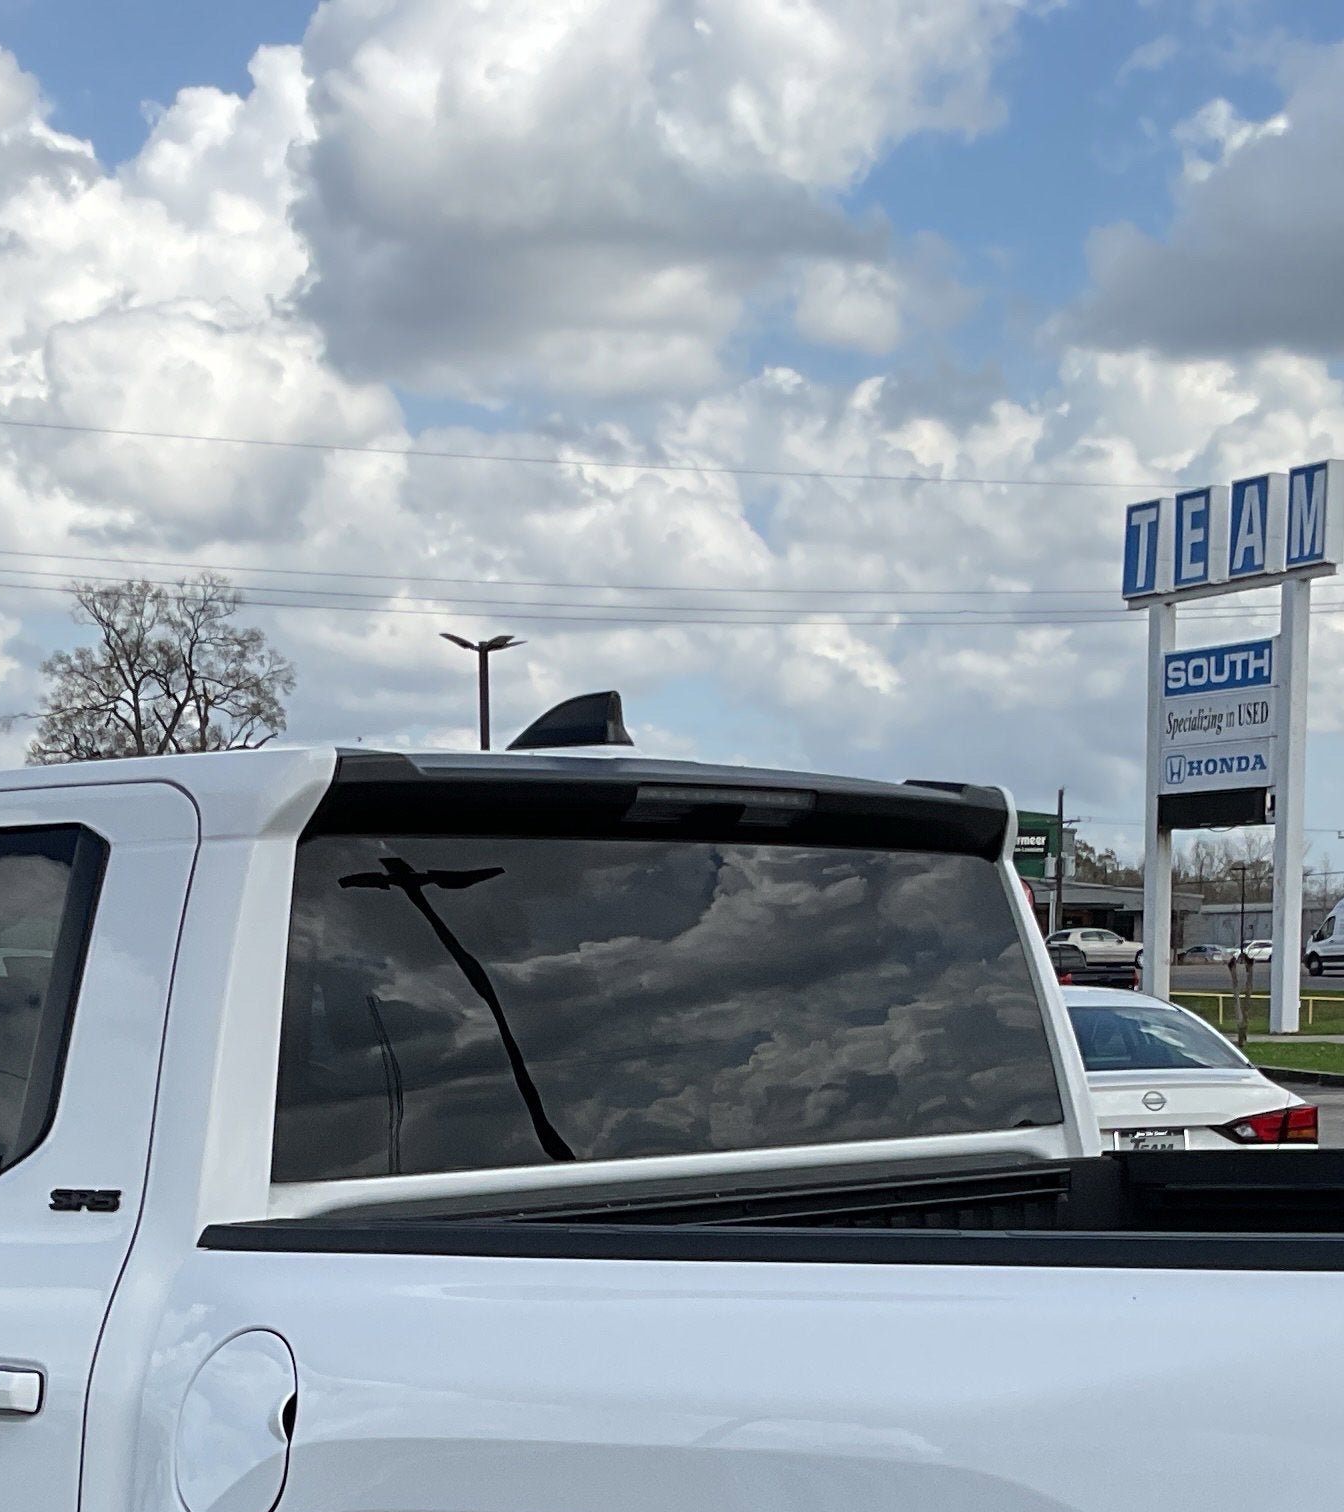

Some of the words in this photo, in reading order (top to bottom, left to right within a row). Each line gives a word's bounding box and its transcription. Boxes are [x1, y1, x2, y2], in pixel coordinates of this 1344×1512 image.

[1131, 469, 1326, 588] TEAM
[1167, 649, 1269, 689] SOUTH
[1166, 708, 1223, 740] Specializing
[1226, 704, 1235, 727] in
[1238, 701, 1269, 727] USED
[1187, 754, 1267, 777] HONDA
[49, 1188, 122, 1212] SR5
